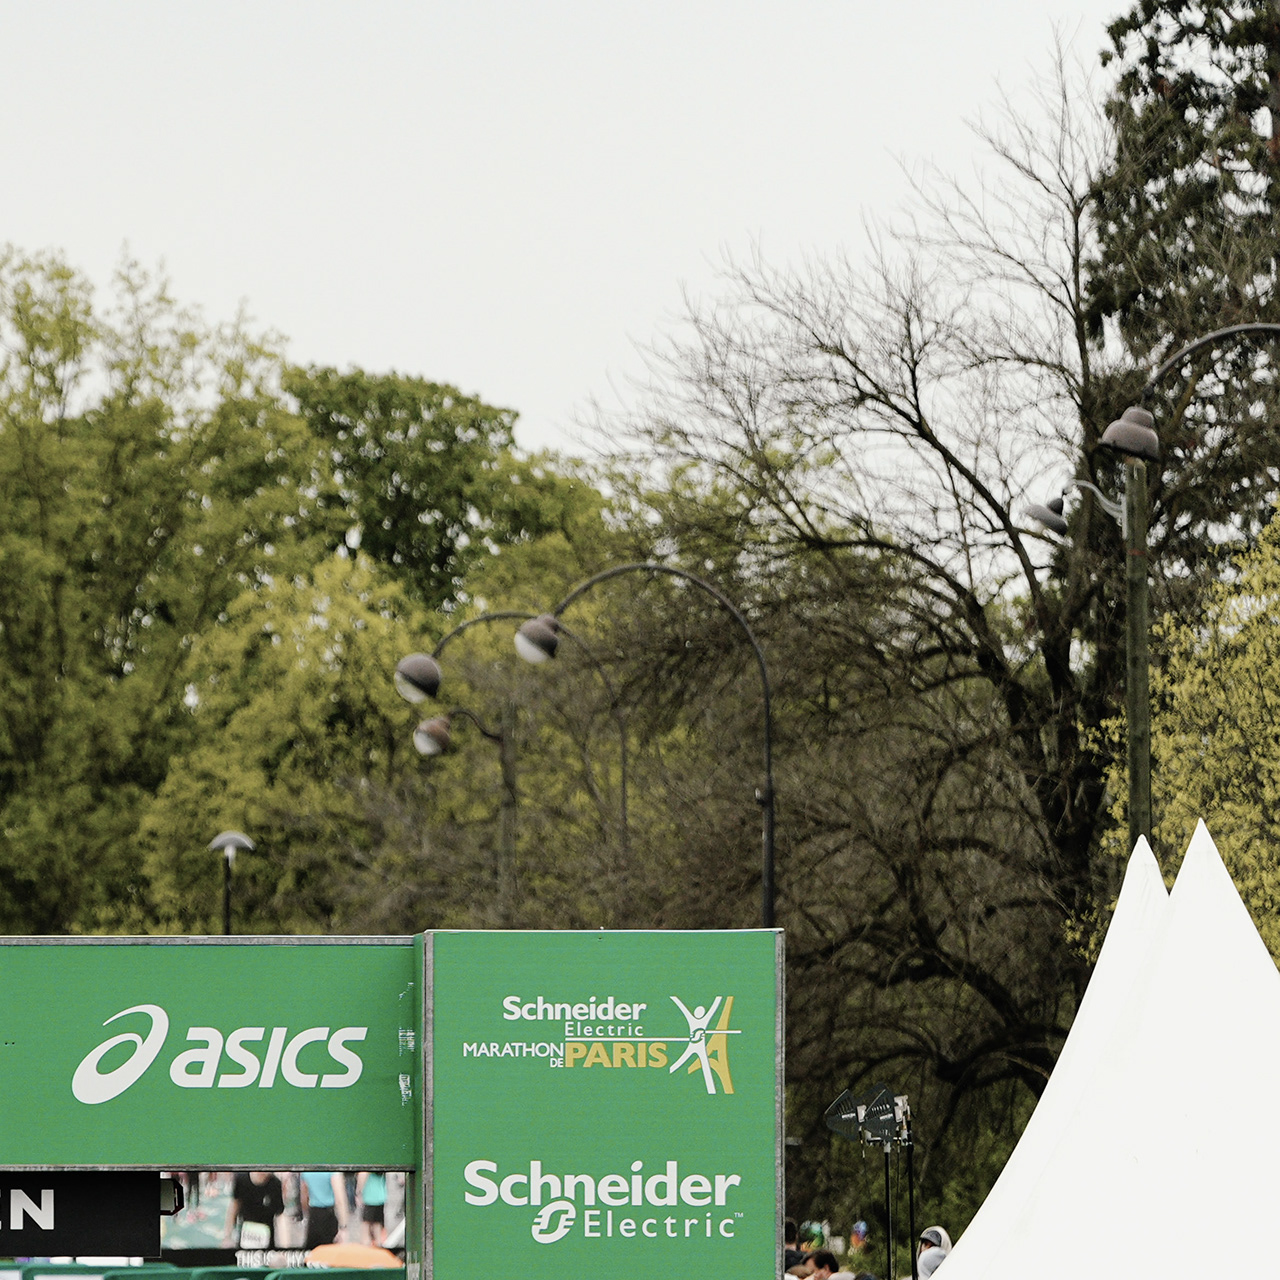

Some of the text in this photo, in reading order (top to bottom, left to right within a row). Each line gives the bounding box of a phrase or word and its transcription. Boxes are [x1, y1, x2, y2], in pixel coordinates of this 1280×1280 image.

[503, 996, 646, 1020] Schneider
[565, 1022, 643, 1036] Electric
[463, 1042, 668, 1067] MARATHON DE PARIS
[464, 1160, 742, 1207] Schneider
[585, 1210, 735, 1237] Electric
